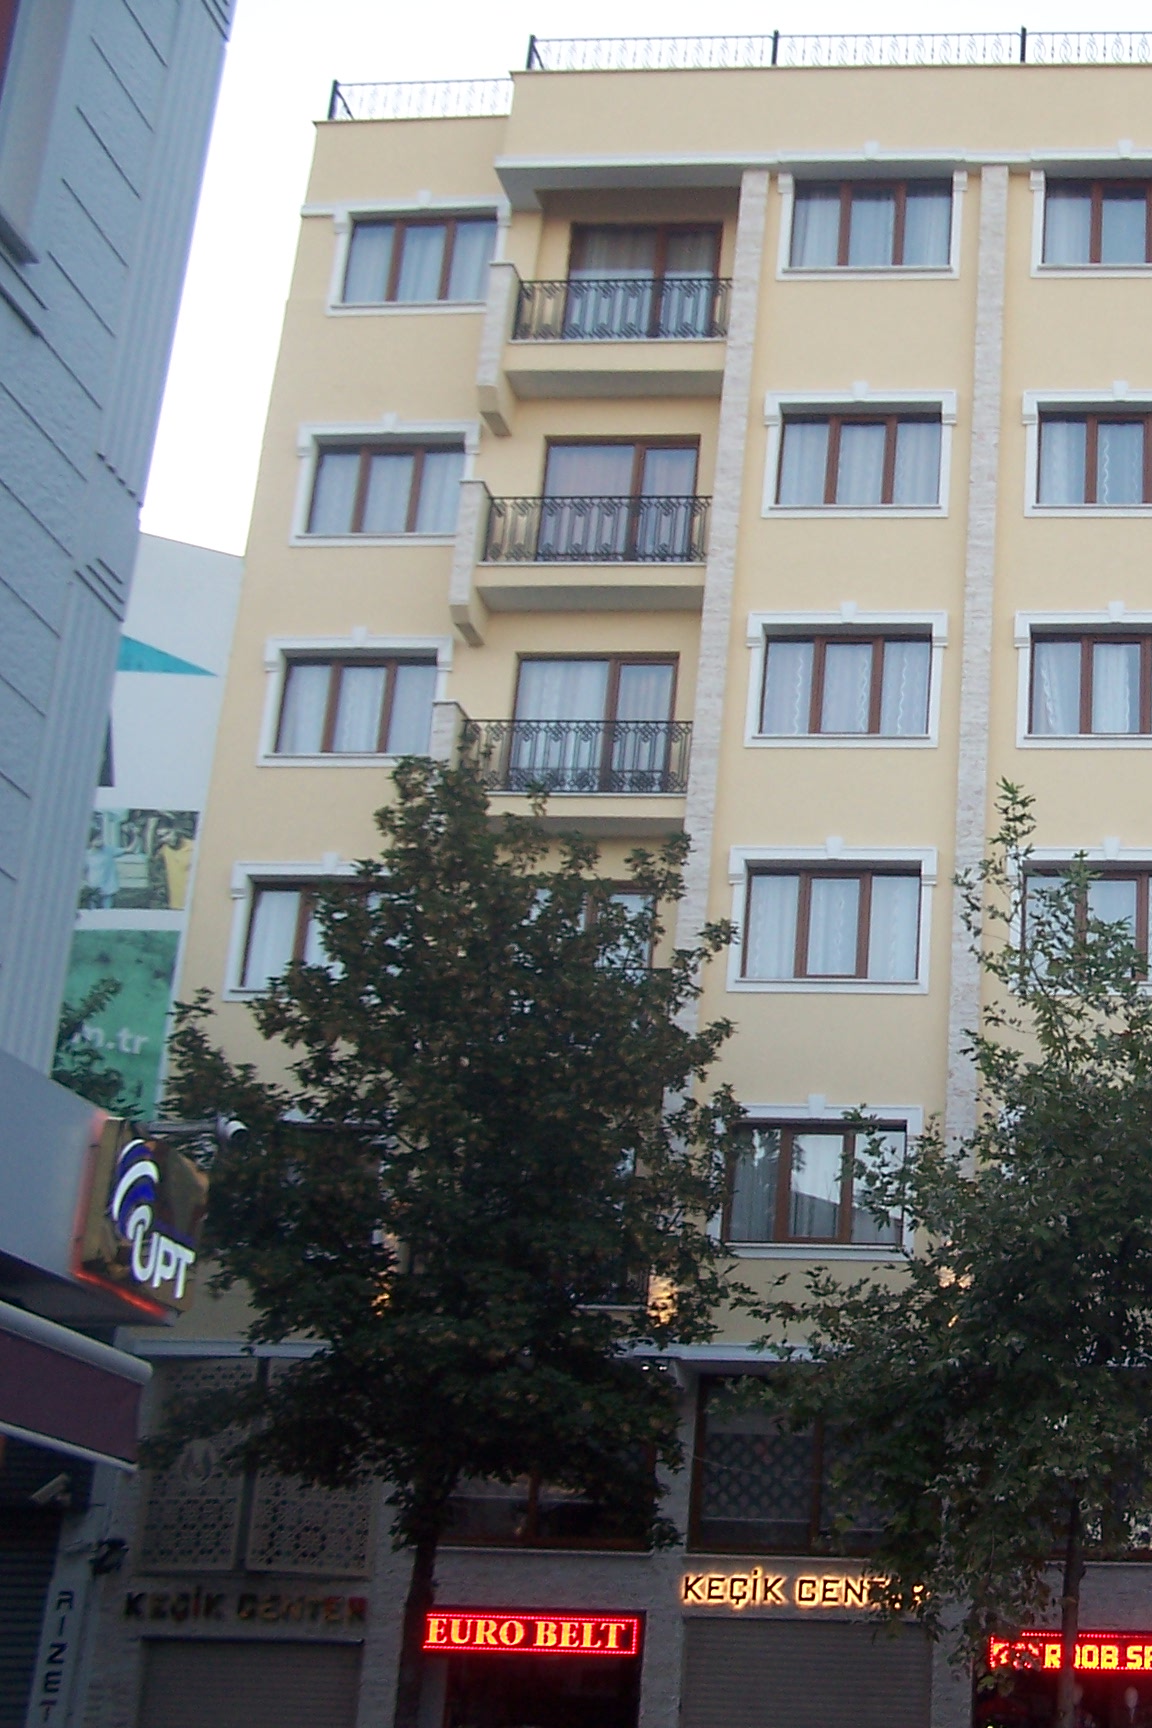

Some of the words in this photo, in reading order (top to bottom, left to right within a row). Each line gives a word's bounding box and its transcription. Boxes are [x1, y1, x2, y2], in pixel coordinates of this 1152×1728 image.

[131, 1231, 196, 1299] UPT
[683, 1568, 785, 1607] KEÇİK
[425, 1618, 525, 1646] EURO
[533, 1620, 627, 1649] BELT
